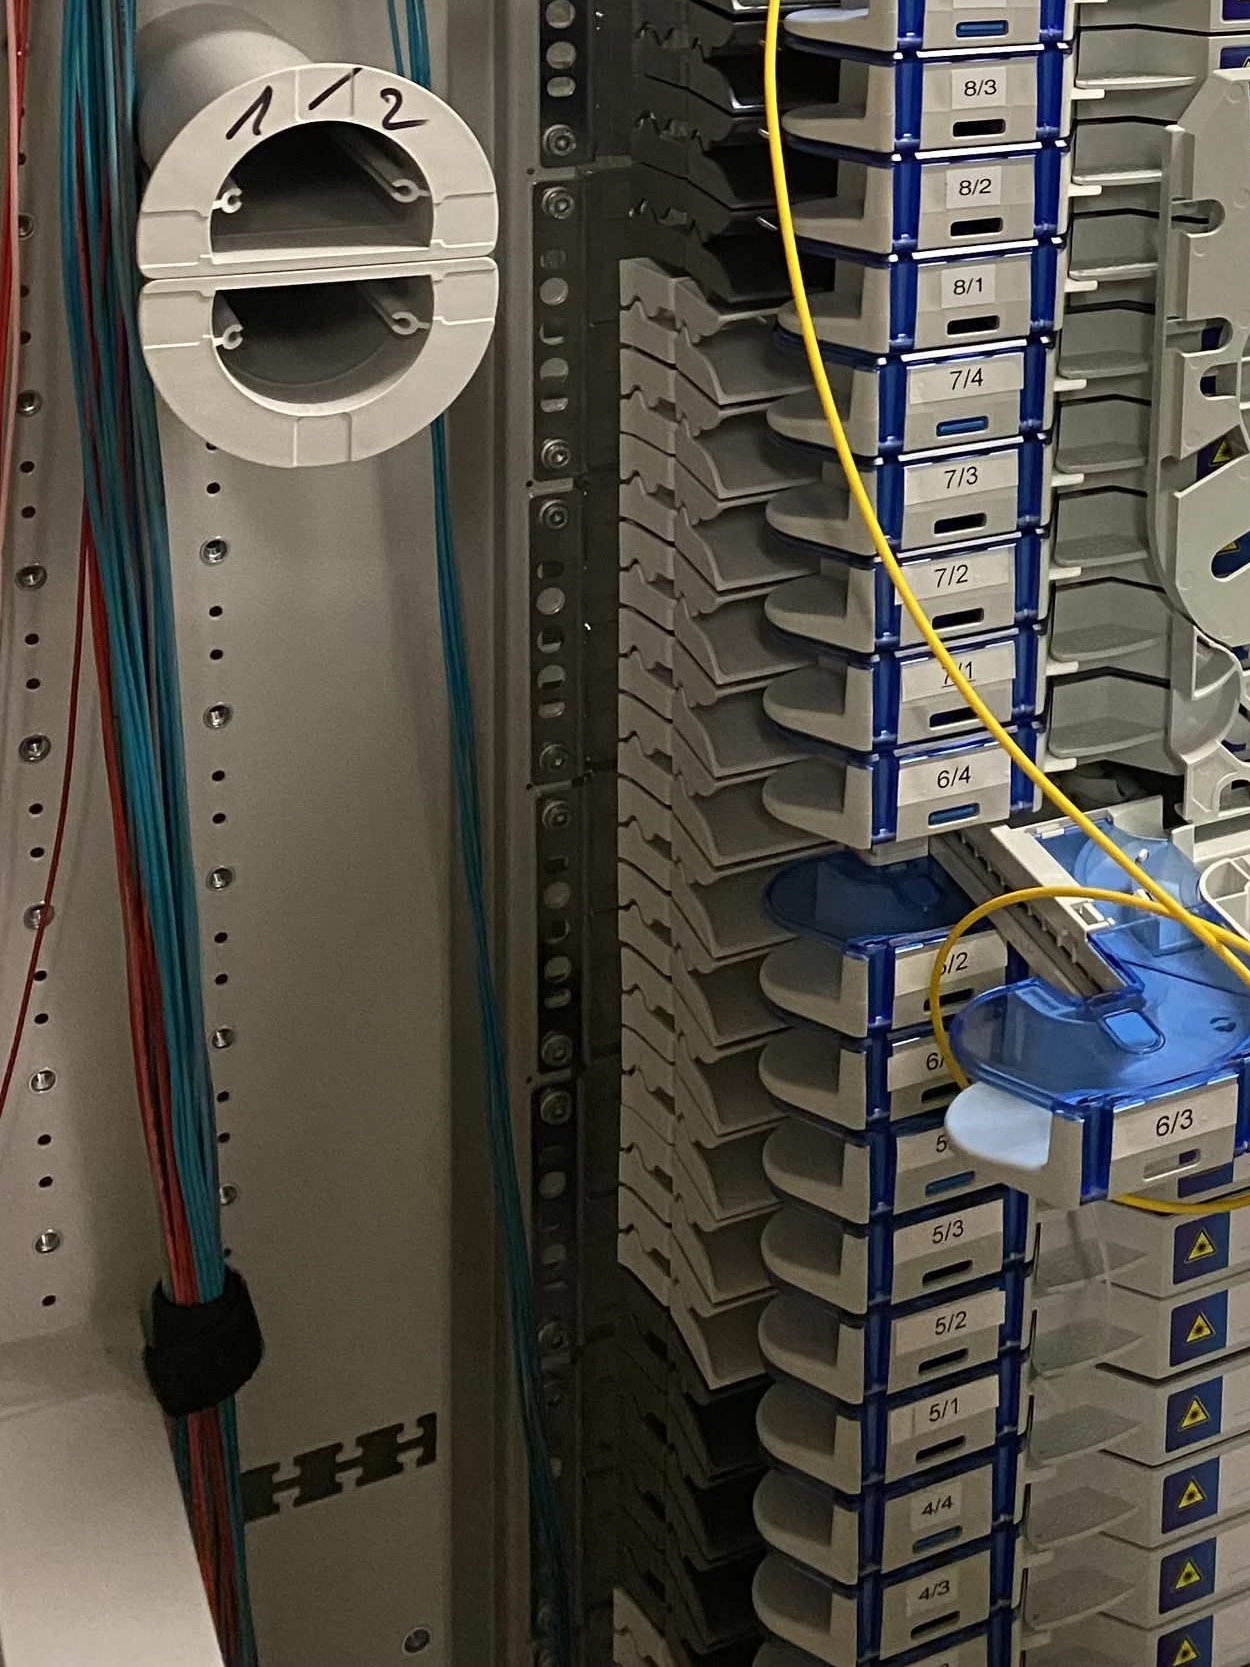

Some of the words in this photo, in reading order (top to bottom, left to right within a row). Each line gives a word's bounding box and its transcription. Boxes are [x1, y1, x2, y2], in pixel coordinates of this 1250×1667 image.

[963, 79, 997, 97] 8/3
[958, 178, 992, 197] 8/2
[953, 278, 984, 296] 8/1
[949, 370, 983, 391] 7/4
[944, 466, 978, 490] 7/3
[934, 564, 968, 588] 7/2
[937, 765, 971, 789] 6/4
[1156, 1108, 1194, 1137] 6/3
[931, 1219, 964, 1245] 5/3
[934, 1311, 967, 1335] 5/2
[928, 1397, 960, 1422] 5/1
[921, 1494, 953, 1516] 4/4
[918, 1579, 950, 1602] 4/3
